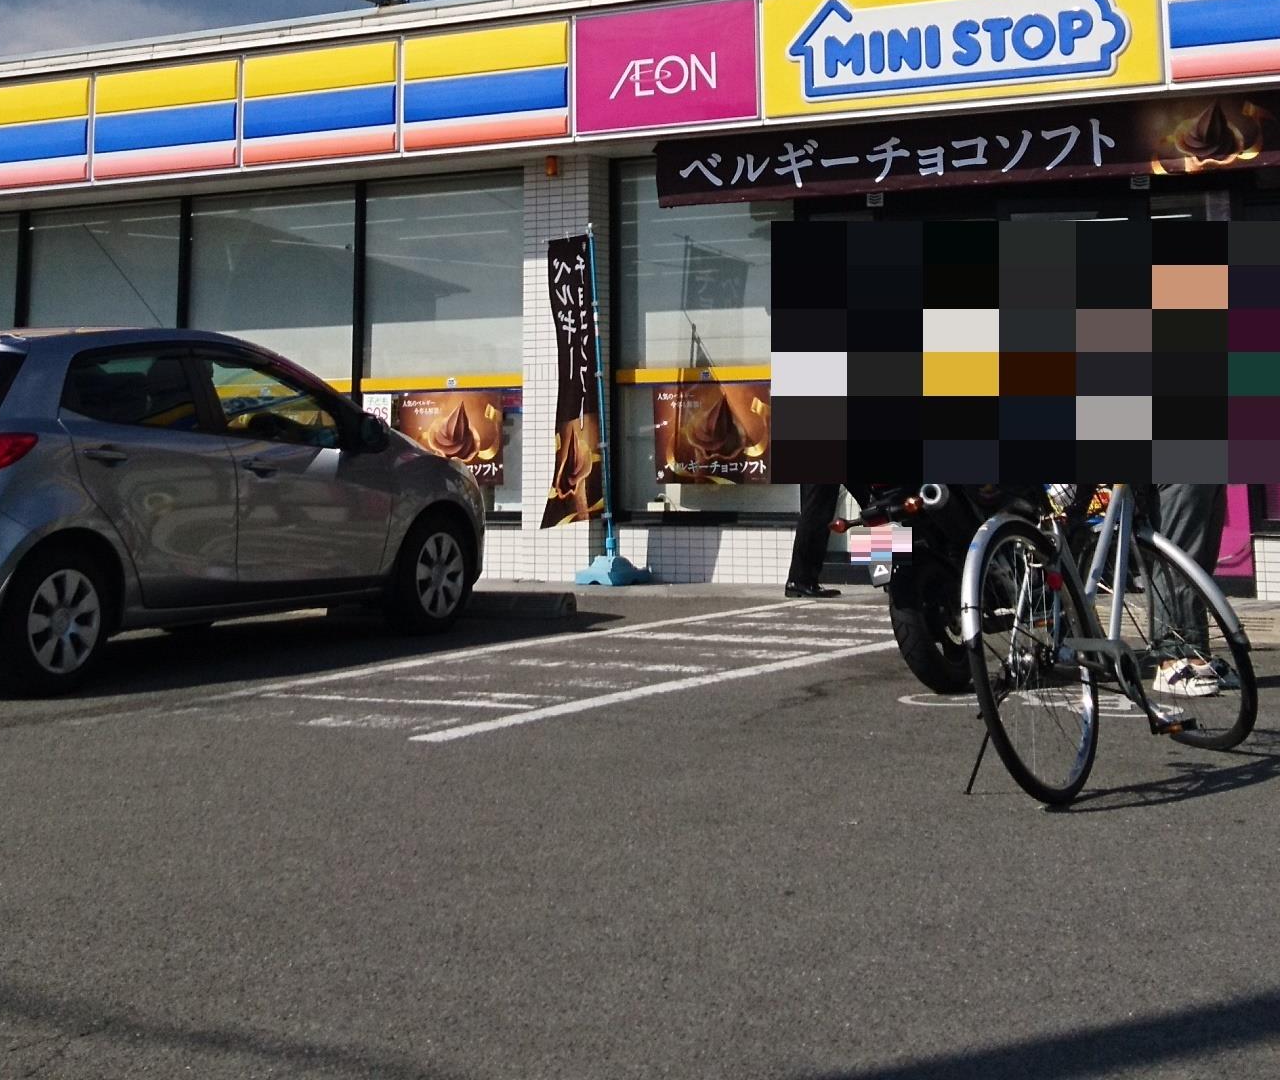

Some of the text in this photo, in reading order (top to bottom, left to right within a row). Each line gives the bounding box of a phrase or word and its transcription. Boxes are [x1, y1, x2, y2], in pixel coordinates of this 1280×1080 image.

[824, 8, 1094, 78] MINI STOP
[679, 118, 1116, 189] ベルギーチョコソフト
